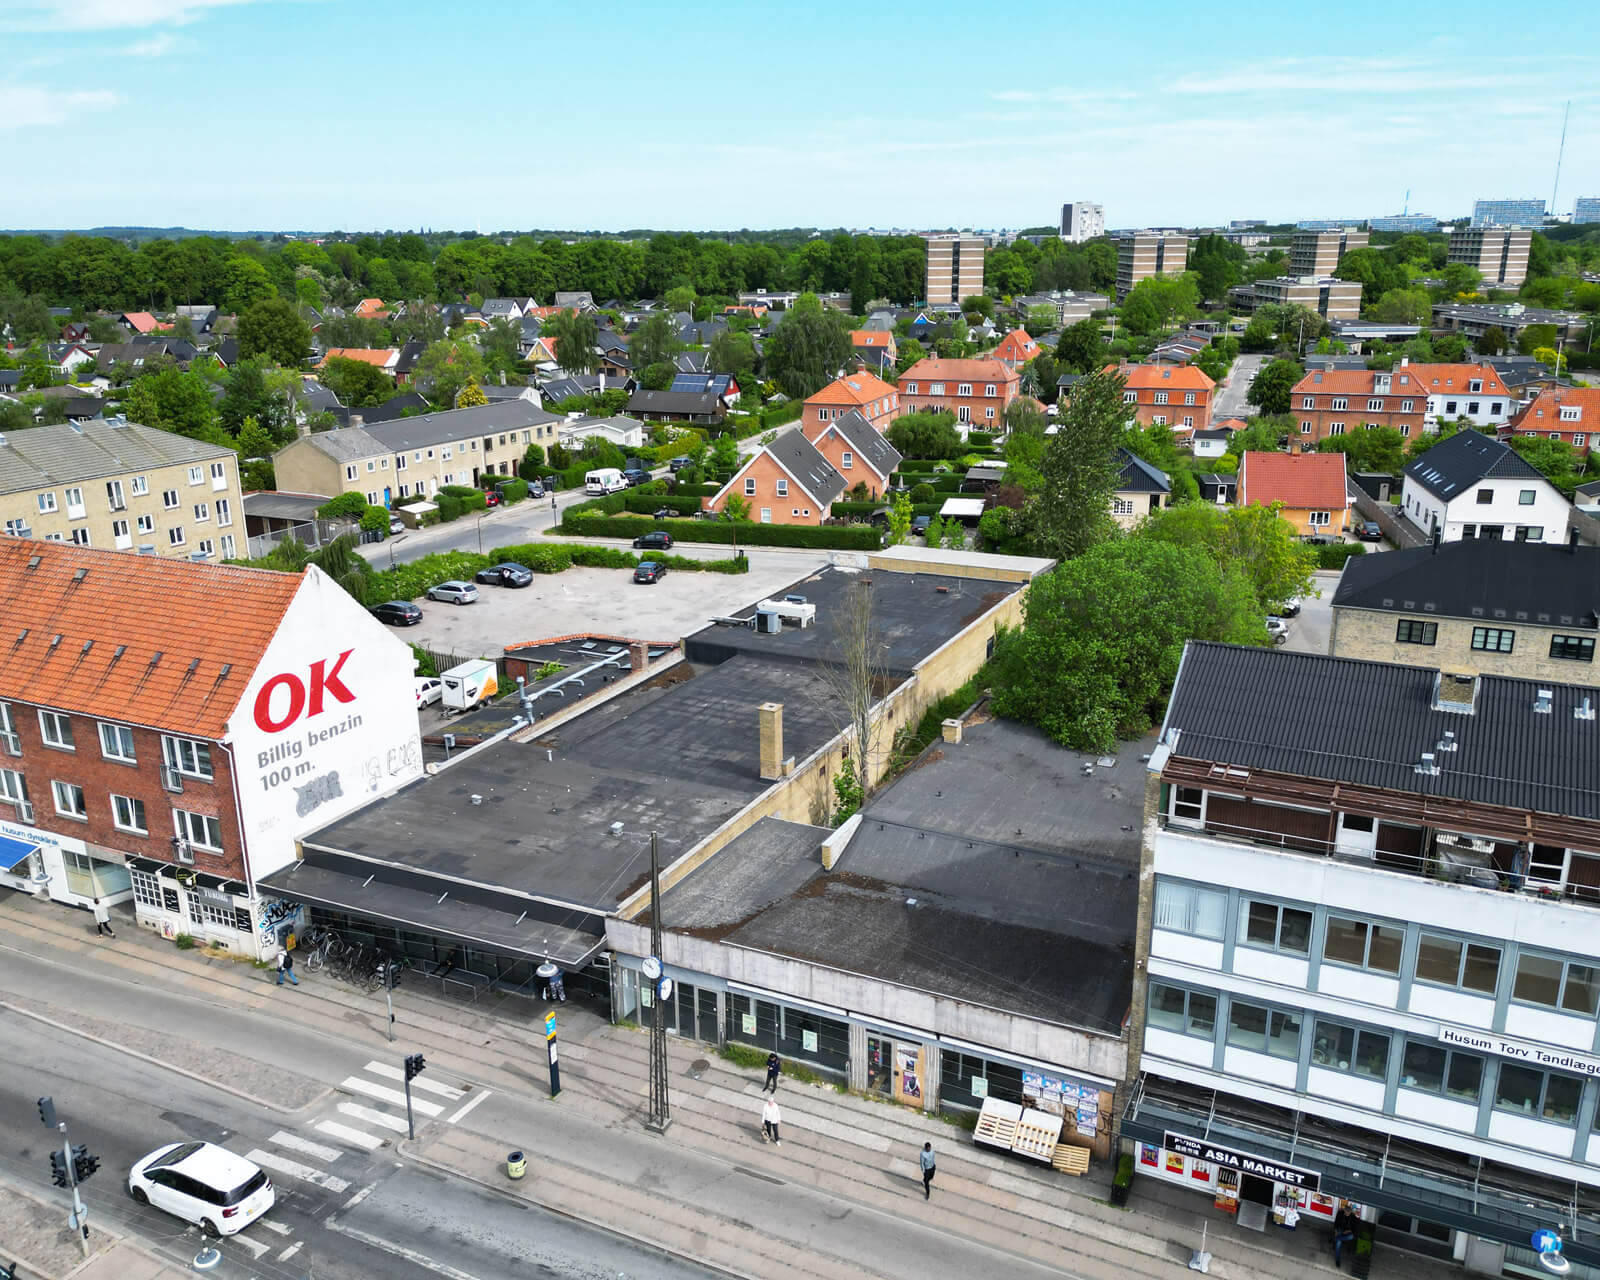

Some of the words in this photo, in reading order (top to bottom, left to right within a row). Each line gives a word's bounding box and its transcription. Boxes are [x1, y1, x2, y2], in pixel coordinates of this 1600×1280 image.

[254, 648, 357, 733] OK
[257, 740, 303, 769] Billig
[308, 714, 363, 748] benzin
[260, 766, 292, 792] 100
[295, 760, 316, 777] m.
[1444, 1030, 1492, 1049] Husum
[1499, 1042, 1529, 1057] Torv
[1205, 1150, 1239, 1167] ASIA
[1243, 1159, 1305, 1184] MARKET
